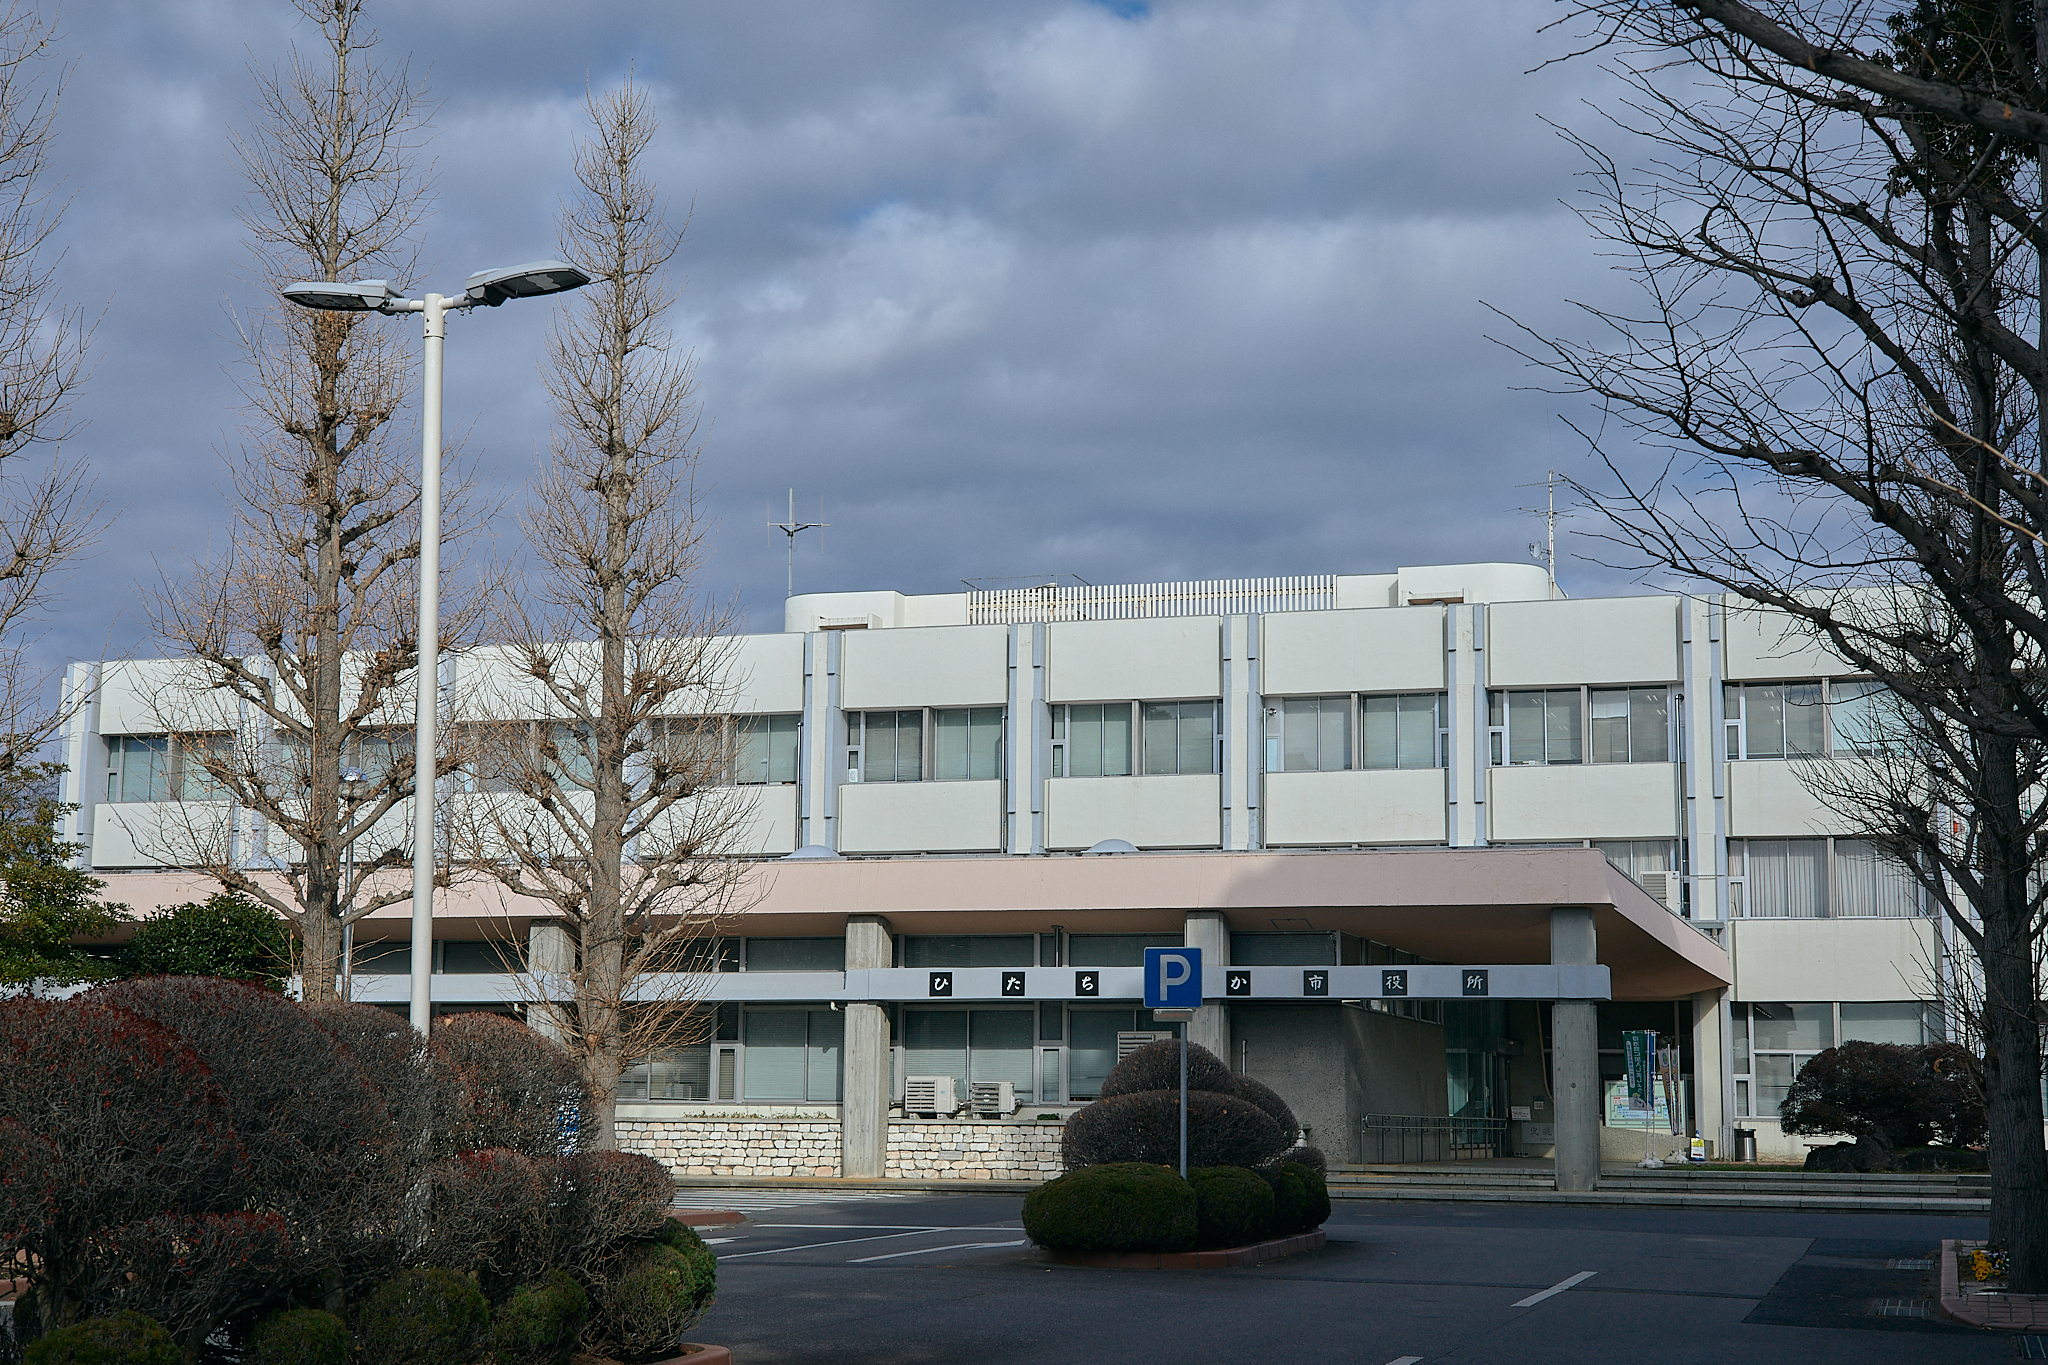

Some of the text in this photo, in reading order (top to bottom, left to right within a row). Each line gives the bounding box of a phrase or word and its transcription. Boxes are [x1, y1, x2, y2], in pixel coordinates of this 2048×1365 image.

[934, 974, 1484, 992] ひたちか市役所
[1160, 954, 1191, 1001] P
